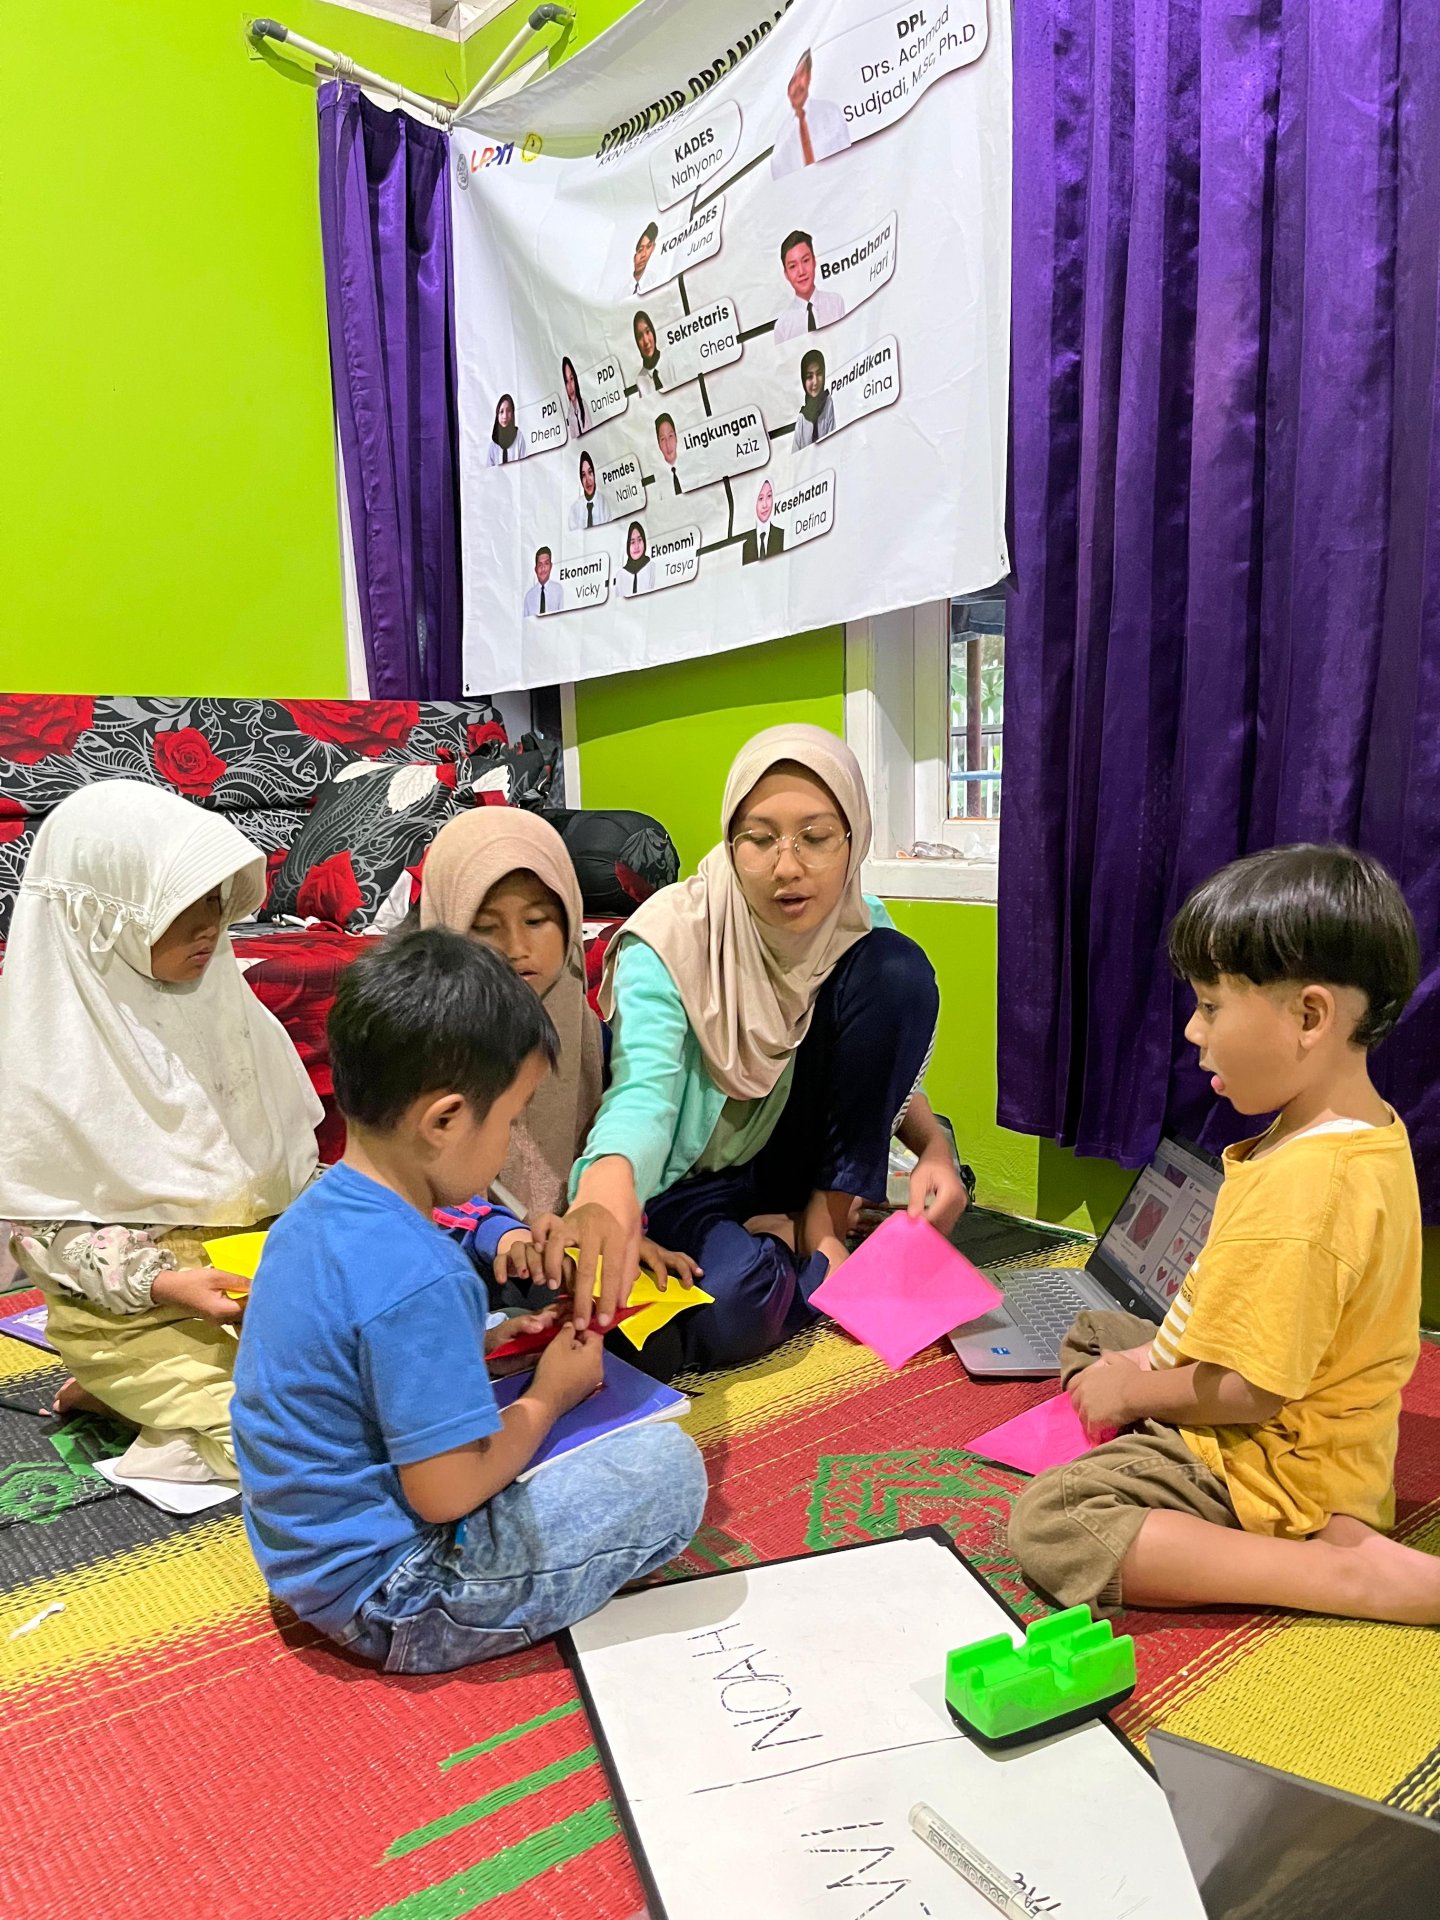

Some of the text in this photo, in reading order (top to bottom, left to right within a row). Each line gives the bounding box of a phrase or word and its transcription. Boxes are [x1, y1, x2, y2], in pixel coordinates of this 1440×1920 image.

[896, 10, 927, 39] DPL
[861, 4, 949, 84] Drs. Achmad
[843, 77, 909, 122] Sudjadi,
[939, 24, 975, 56] Ph.D
[674, 127, 715, 163] KADES
[671, 149, 723, 189] Nahyono
[660, 205, 718, 255] KORMADES
[687, 231, 714, 256] Juna
[820, 225, 891, 280] Bendahara
[869, 250, 889, 282] Hari
[667, 305, 730, 346] Sekretaris
[700, 334, 735, 358] Ghea
[597, 365, 615, 384] PDD
[830, 347, 891, 396] Pendidikan
[863, 375, 893, 399] Gina
[541, 401, 557, 419] PDD
[590, 390, 621, 413] Danisa
[530, 425, 561, 444] Dhena
[684, 413, 757, 450] Lingkungan
[736, 437, 760, 458] Aziz
[602, 461, 635, 485] Pemdes
[615, 484, 638, 502] Naila
[773, 479, 829, 516] Kesehatan
[795, 509, 827, 535] Defina
[651, 532, 695, 559] Ekonomi
[559, 558, 602, 581] Ekonomi
[665, 556, 694, 577] Tasya
[575, 583, 600, 599] Vicky
[687, 1623, 824, 1751] NOAH
